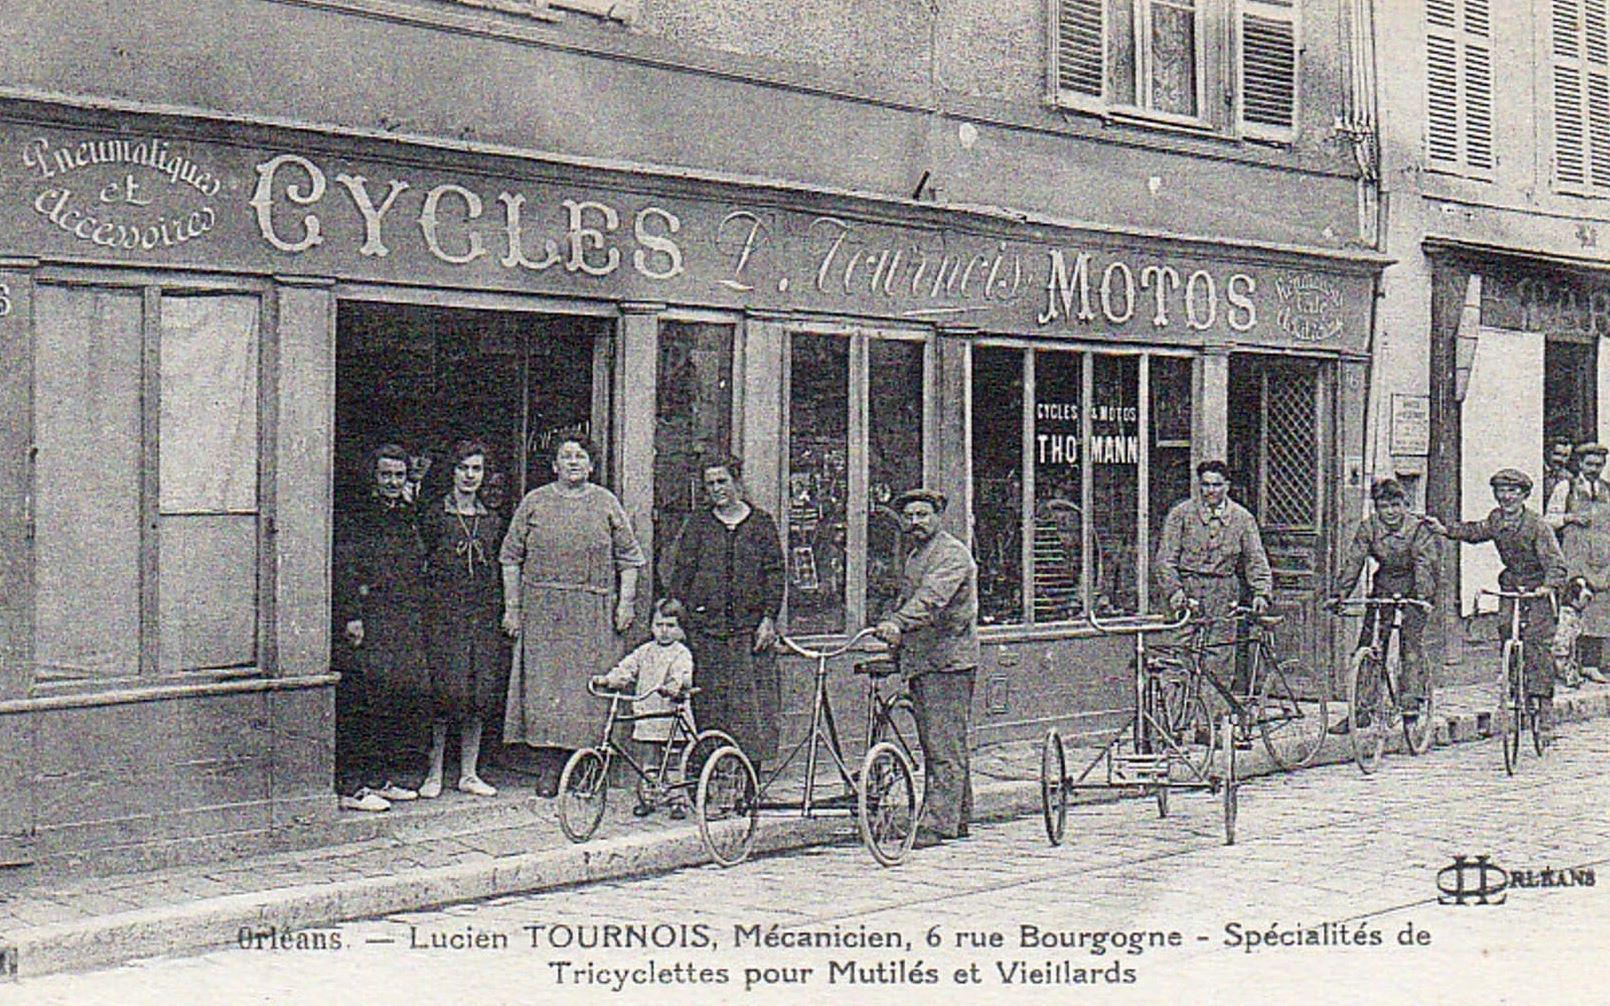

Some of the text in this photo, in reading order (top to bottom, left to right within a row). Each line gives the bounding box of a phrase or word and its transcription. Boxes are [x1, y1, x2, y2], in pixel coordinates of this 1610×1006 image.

[23, 137, 220, 196] Pneumatiques
[101, 174, 150, 206] et
[35, 188, 215, 250] Accessoires
[249, 154, 685, 280] CYCLES
[1037, 249, 1258, 331] MOTOS
[1037, 403, 1078, 420] CYCLES
[1100, 405, 1136, 421] MOTOS
